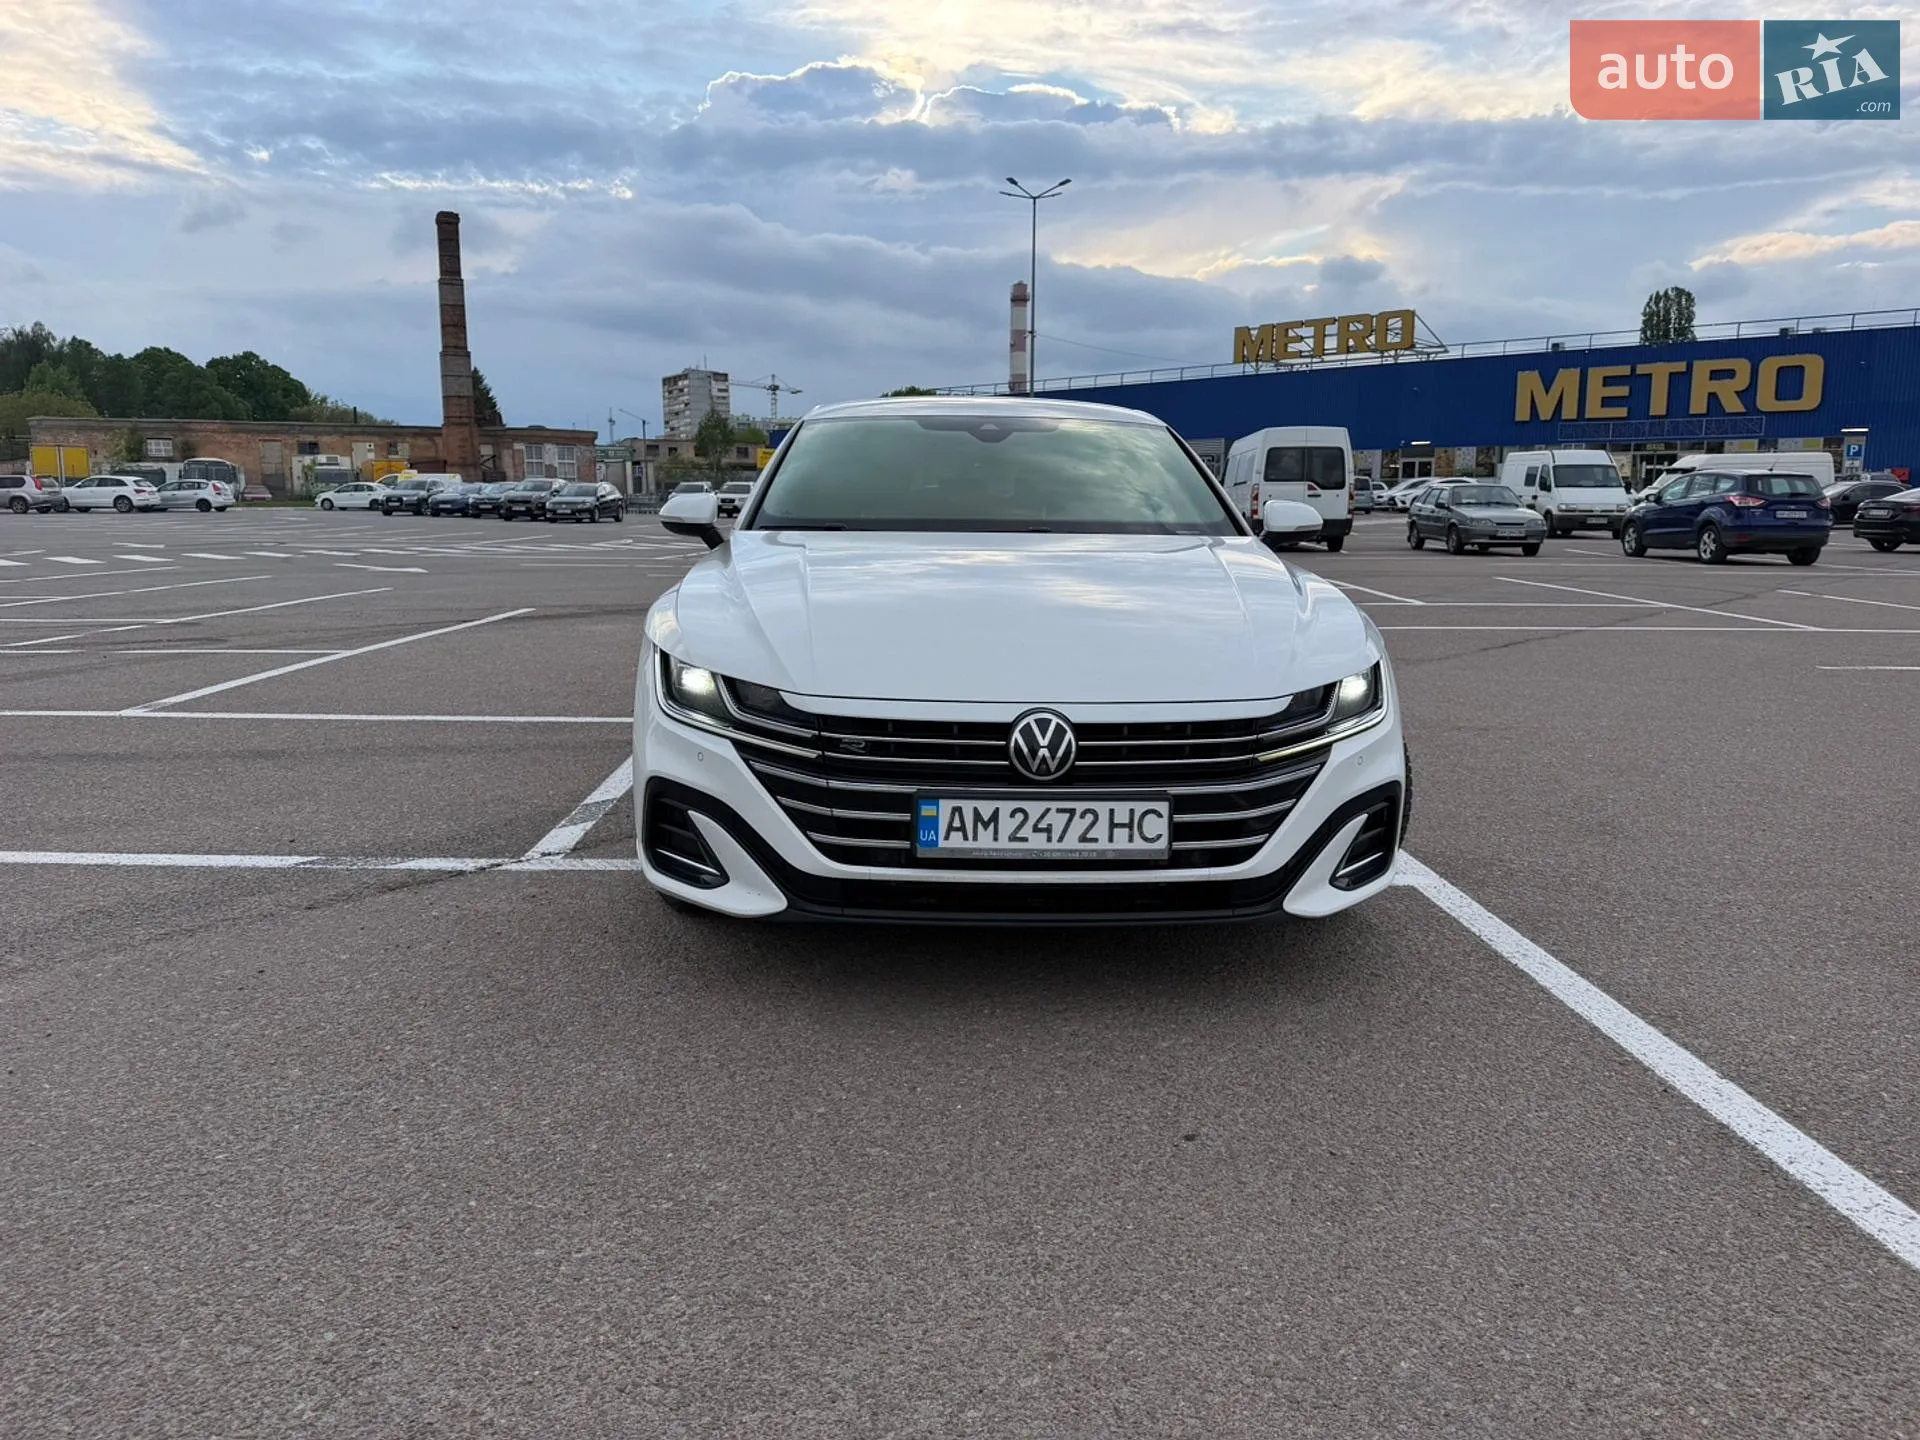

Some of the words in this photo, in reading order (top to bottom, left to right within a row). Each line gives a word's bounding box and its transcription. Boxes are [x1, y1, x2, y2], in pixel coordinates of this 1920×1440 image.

[1233, 309, 1416, 364] METRO
[1514, 353, 1825, 422] METRO
[1849, 445, 1859, 456] P
[920, 830, 937, 842] UA
